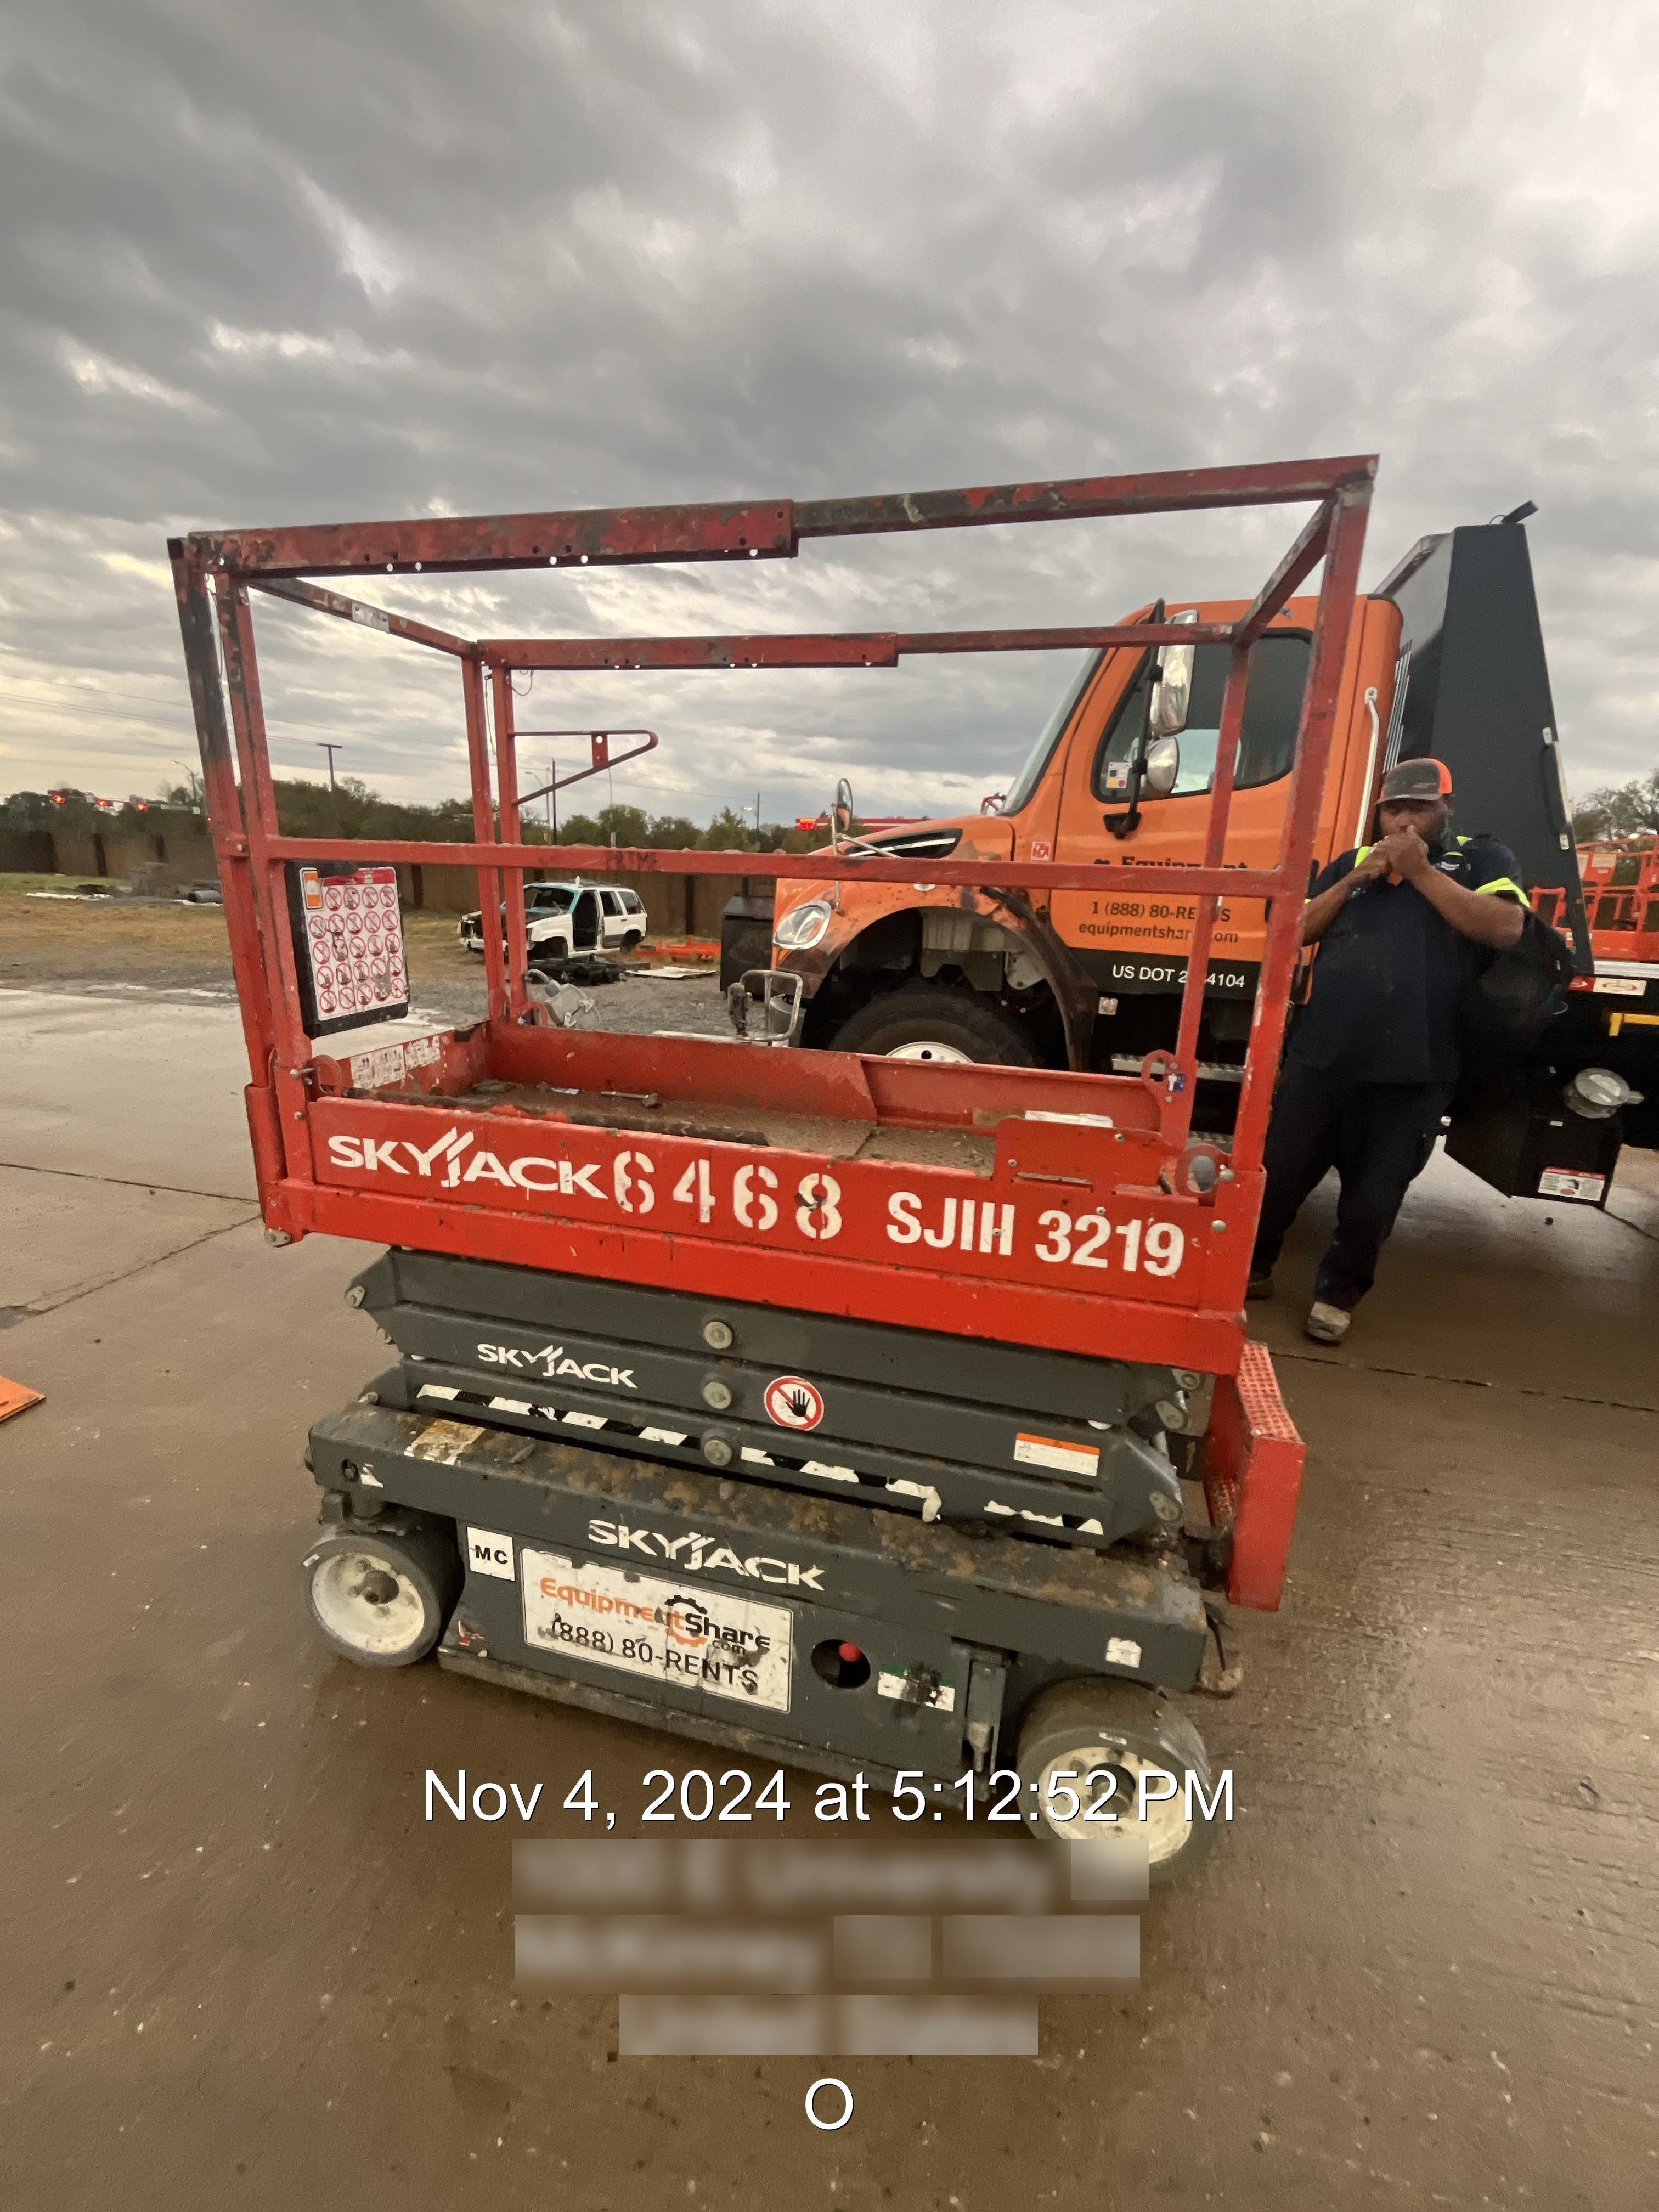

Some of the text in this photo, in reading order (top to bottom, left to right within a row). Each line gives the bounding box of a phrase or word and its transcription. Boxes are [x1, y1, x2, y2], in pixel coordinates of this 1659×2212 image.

[1092, 902, 1232, 922] 1 (888) 80-RES
[1079, 922, 1238, 943] equipmentsharom
[1112, 964, 1245, 988] US DOT 24104
[328, 1126, 608, 1199] SKYJACK
[1035, 1209, 1186, 1276] 3219
[477, 1343, 638, 1389] SKYJACK
[475, 1544, 509, 1565] MC
[588, 1519, 825, 1591] SKYJACK
[552, 1615, 759, 1693] (888) 80-RENTS
